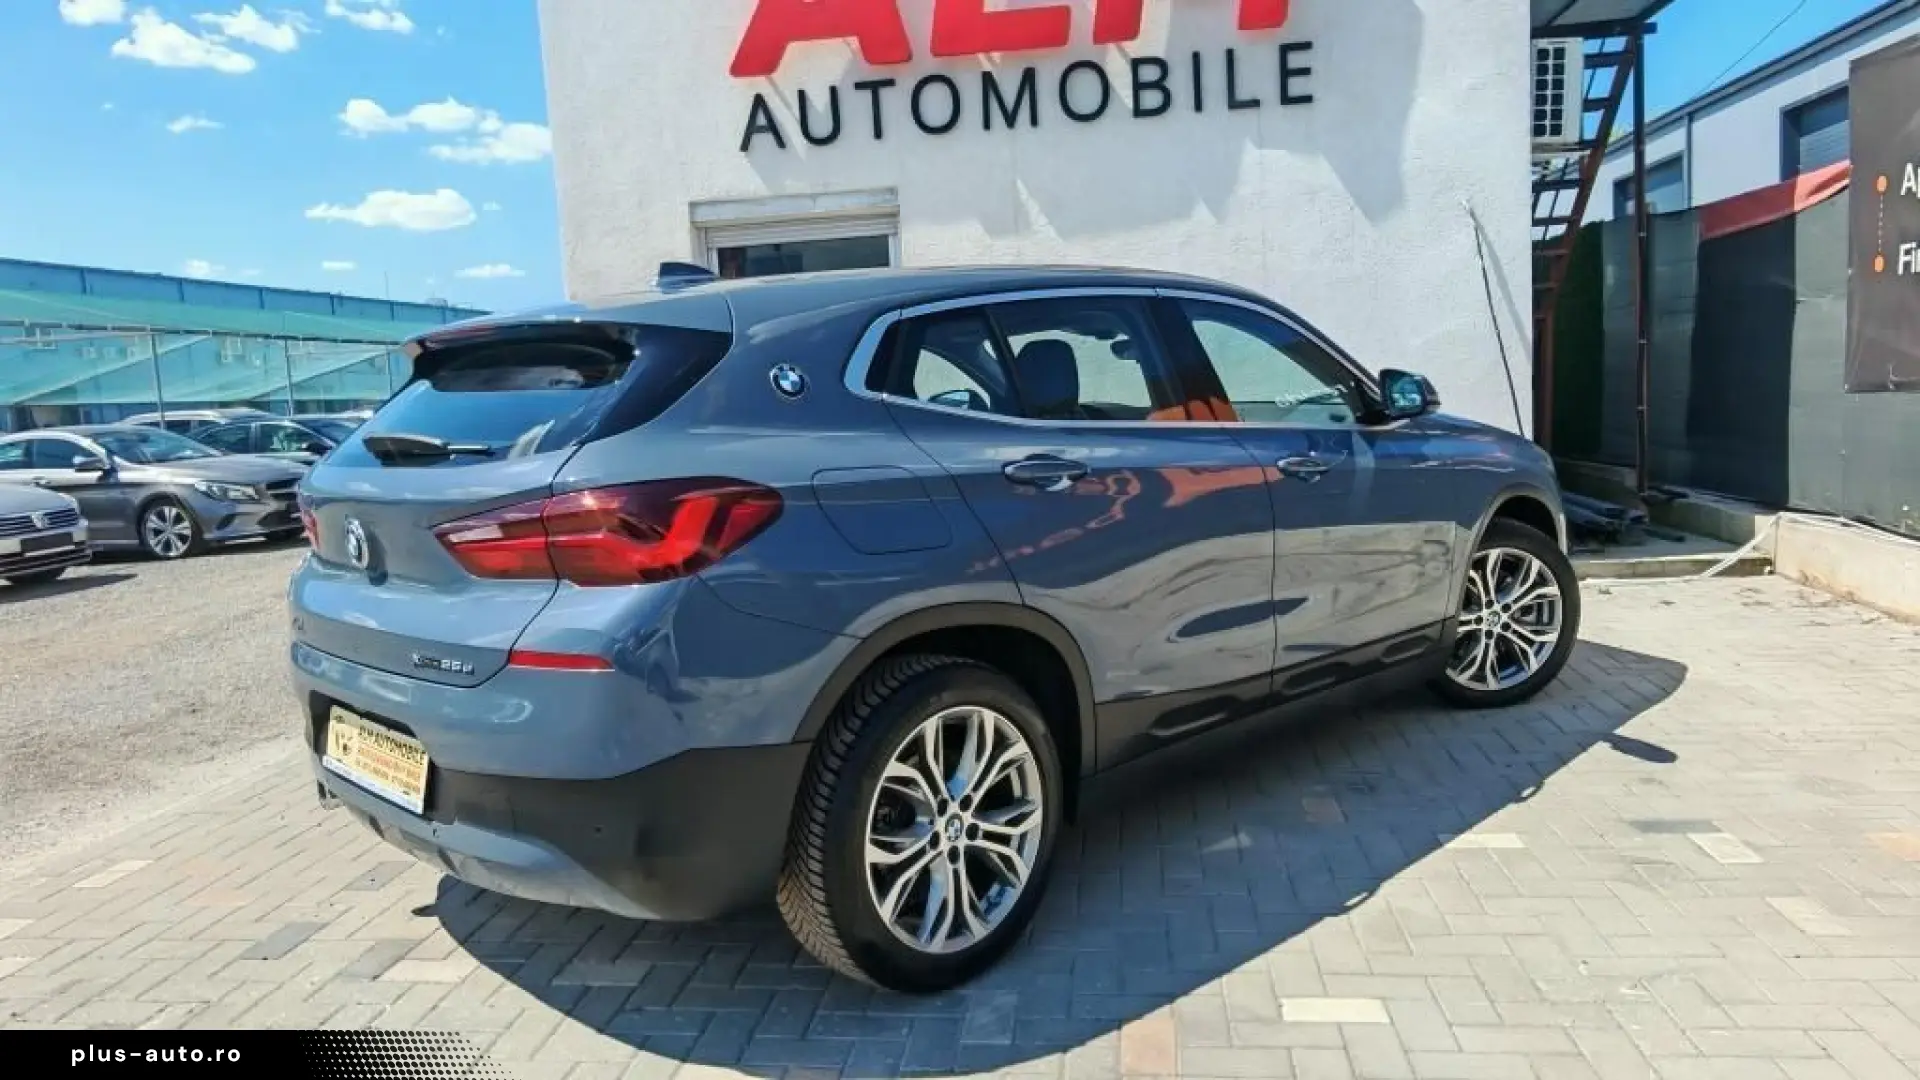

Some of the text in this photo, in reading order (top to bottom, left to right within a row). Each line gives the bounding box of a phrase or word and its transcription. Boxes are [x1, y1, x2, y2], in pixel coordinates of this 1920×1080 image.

[739, 41, 1315, 152] AUTOMOBILE
[1900, 161, 1920, 200] A
[1897, 241, 1920, 276] Fi
